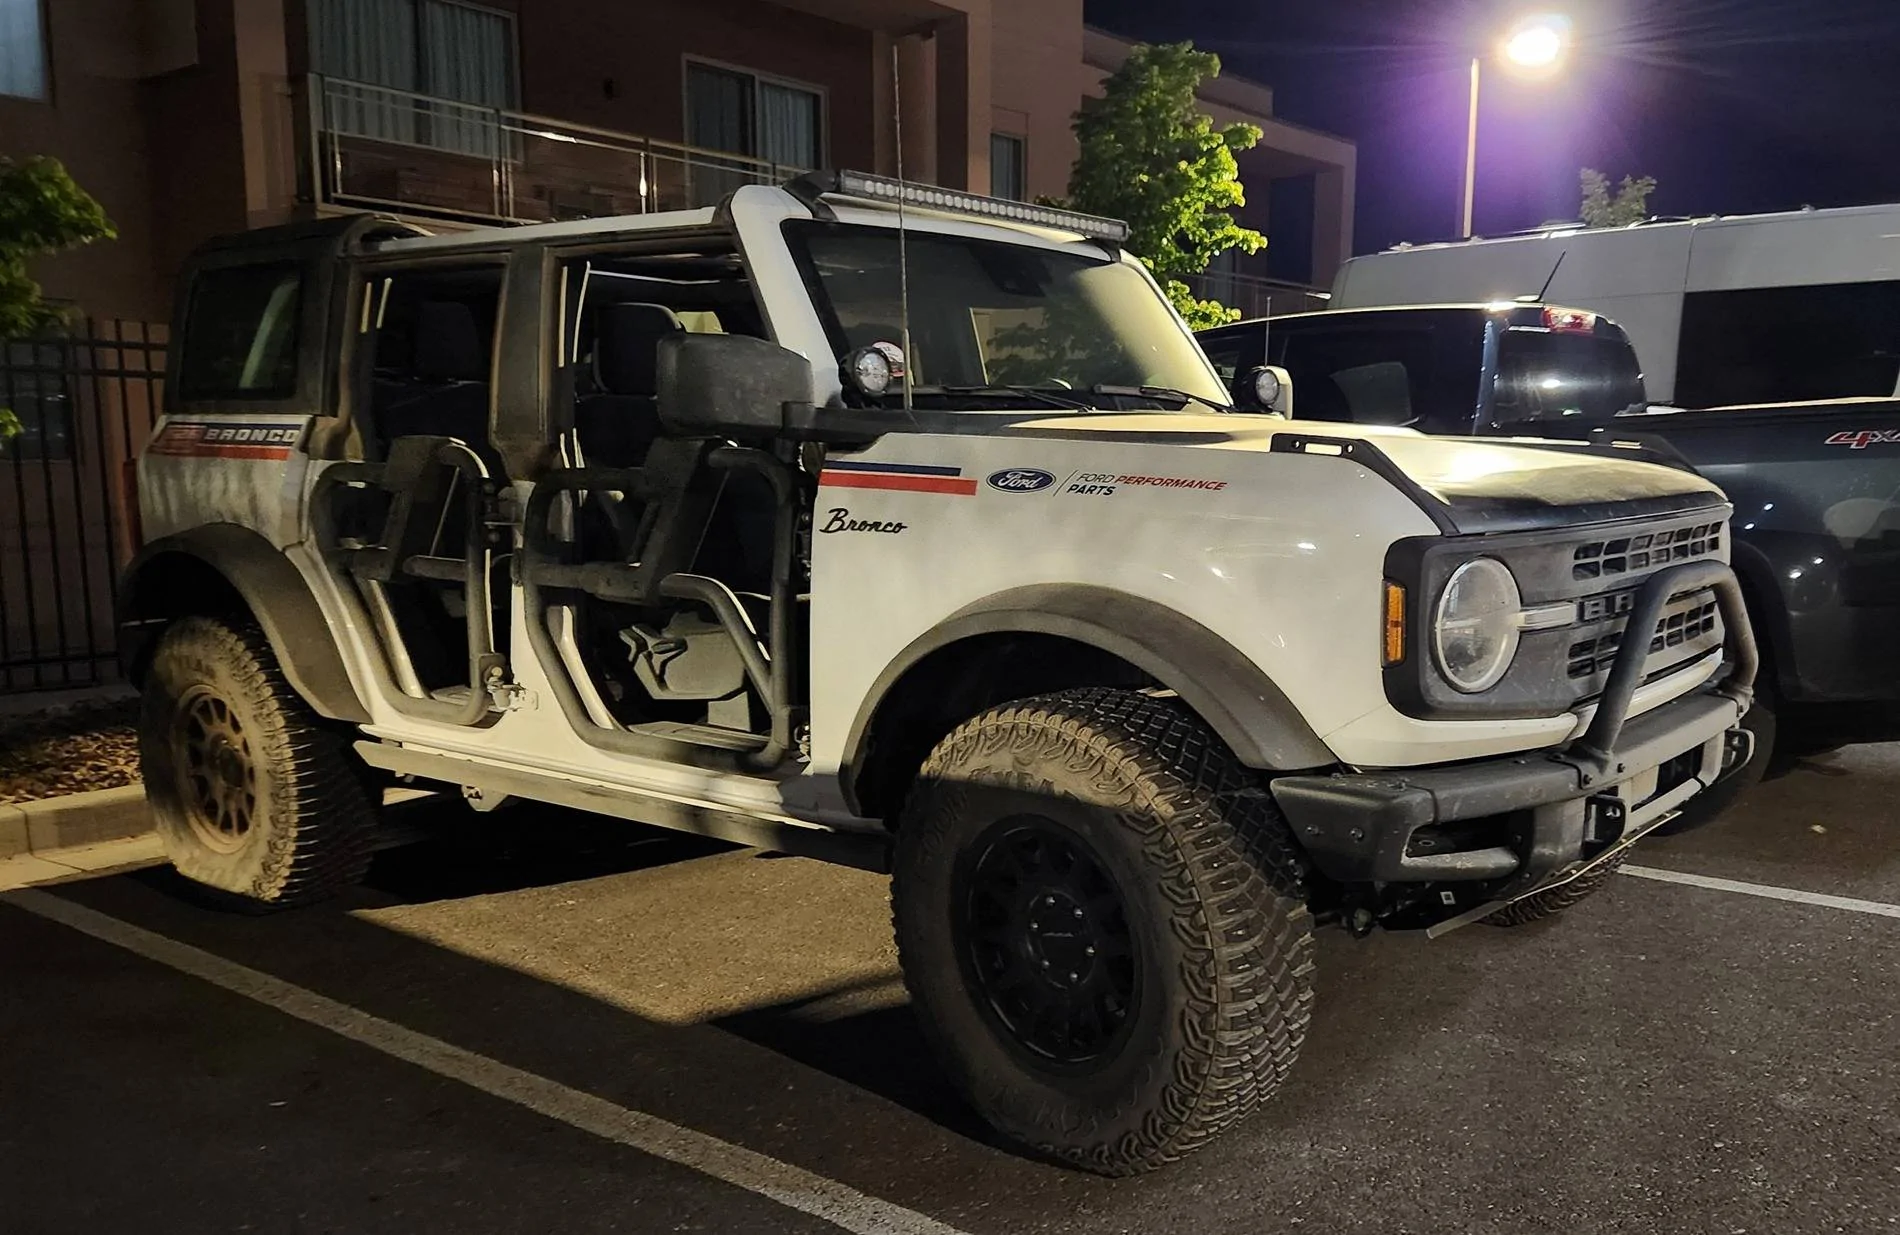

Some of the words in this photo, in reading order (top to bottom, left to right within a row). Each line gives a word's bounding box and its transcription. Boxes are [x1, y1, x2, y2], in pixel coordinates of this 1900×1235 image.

[203, 428, 300, 442] BRONCO
[996, 470, 1045, 490] Ford
[1076, 473, 1115, 483] FORD
[1114, 474, 1228, 491] PERFORMANCE
[1066, 483, 1116, 496] PARTS
[818, 507, 908, 534] Bronco
